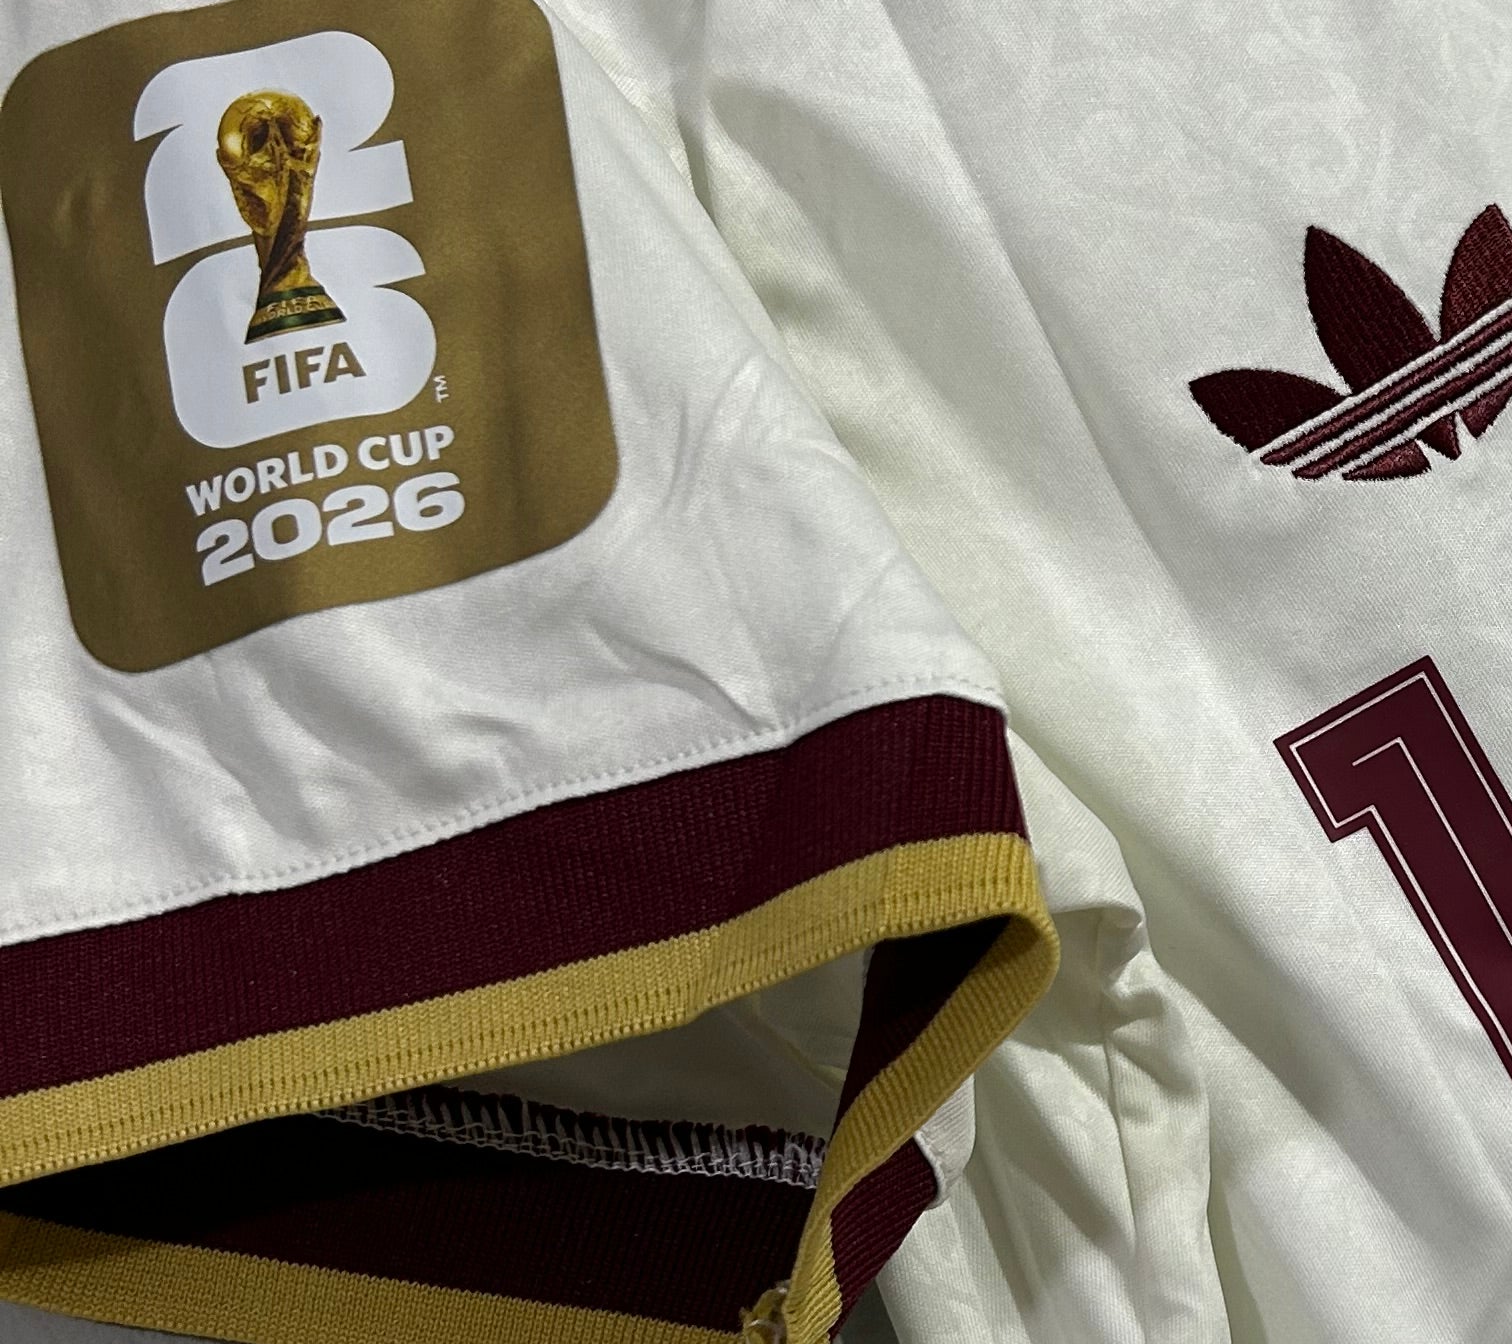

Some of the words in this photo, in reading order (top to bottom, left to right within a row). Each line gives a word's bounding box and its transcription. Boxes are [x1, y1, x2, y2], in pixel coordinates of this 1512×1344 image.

[242, 342, 367, 404] FIFA
[434, 375, 449, 403] TM
[186, 444, 349, 516] WORLD
[358, 425, 455, 470] CUP
[197, 472, 465, 587] 2026
